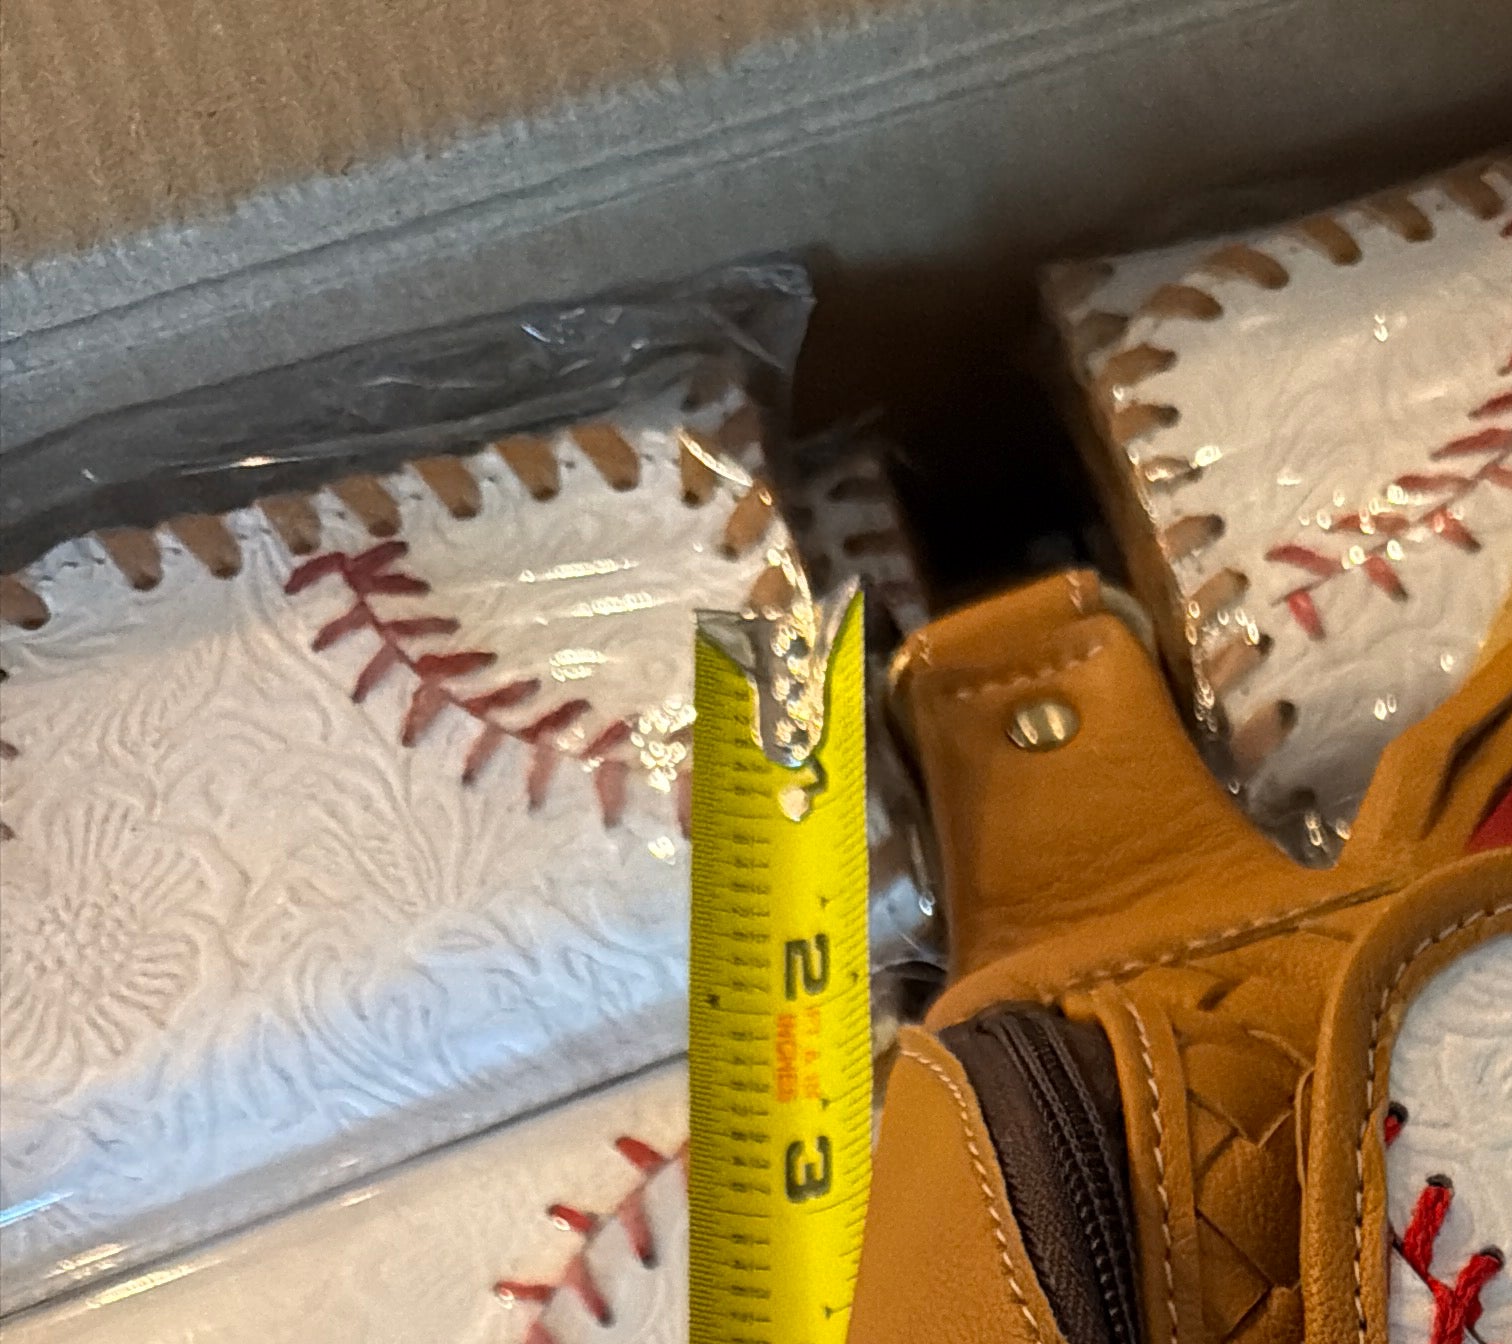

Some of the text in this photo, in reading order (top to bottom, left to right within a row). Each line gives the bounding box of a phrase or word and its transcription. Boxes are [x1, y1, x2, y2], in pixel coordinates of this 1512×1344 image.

[784, 935, 829, 1001] 2
[776, 1014, 797, 1103] INCHES
[784, 1136, 832, 1206] 3
